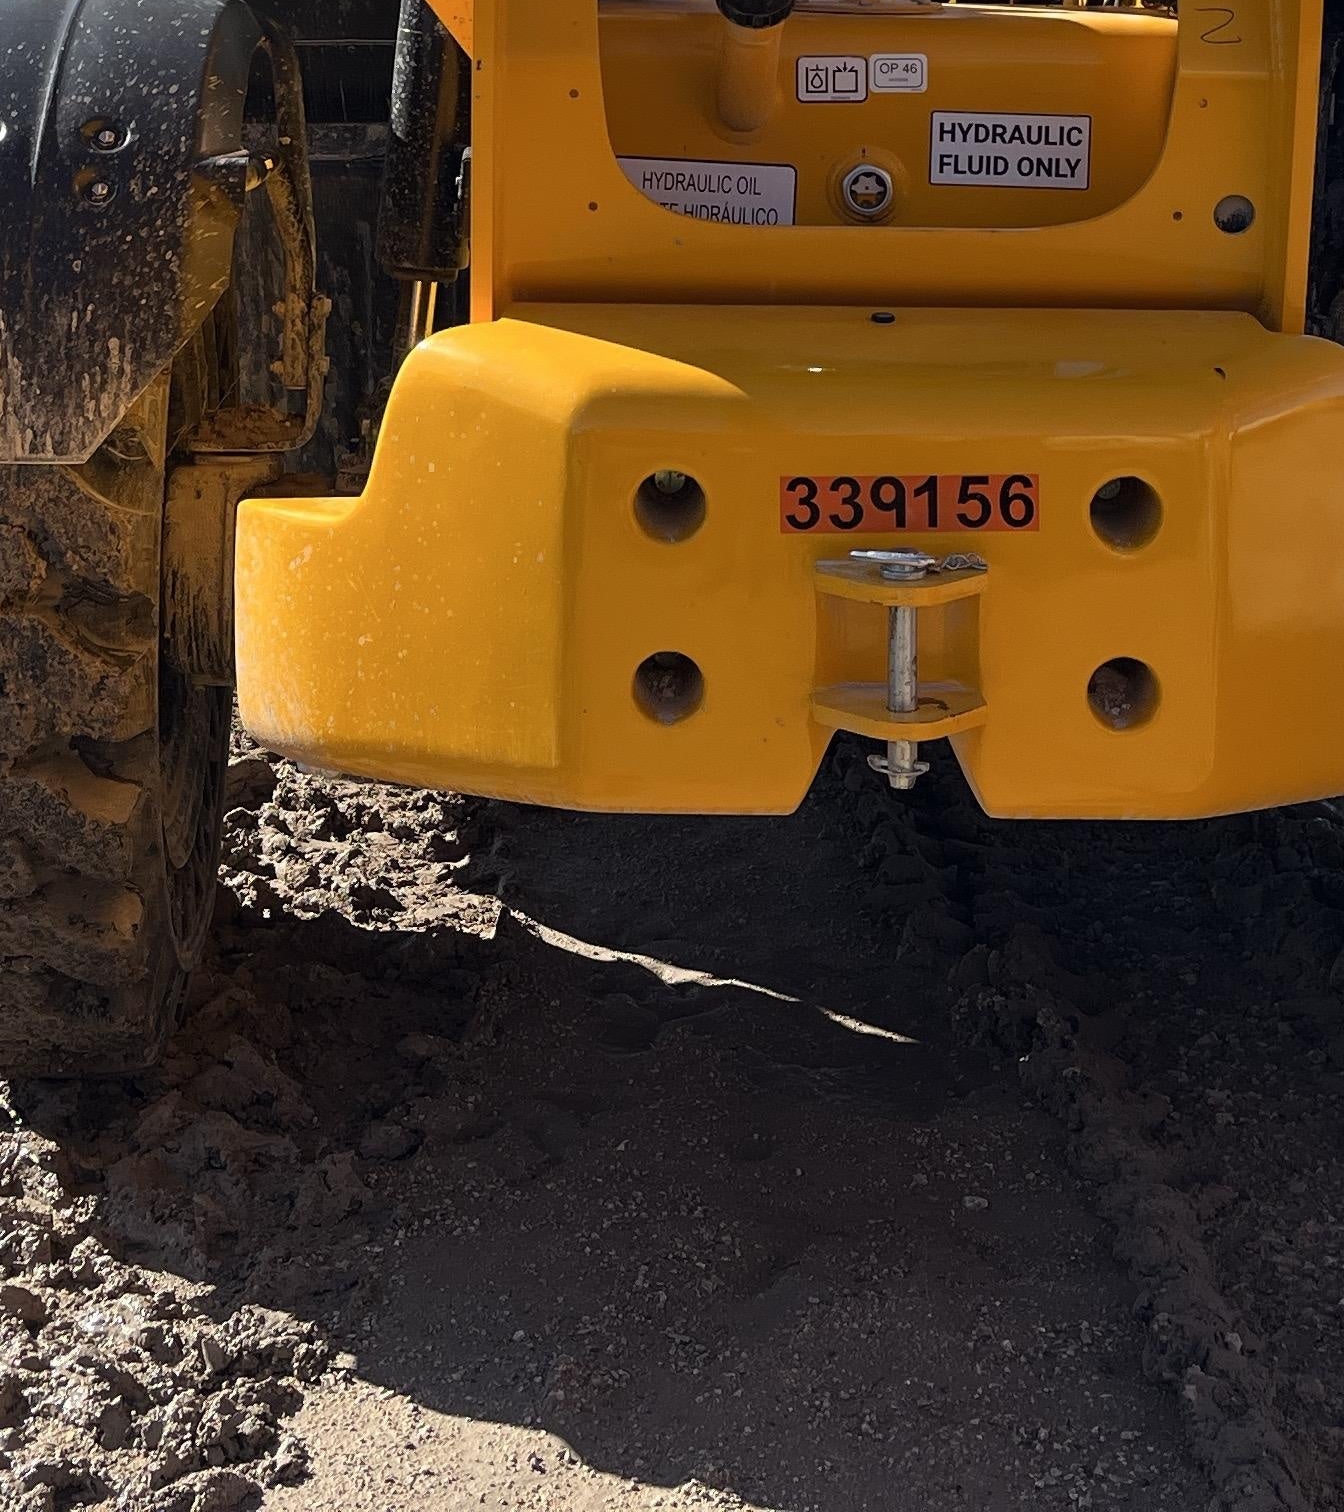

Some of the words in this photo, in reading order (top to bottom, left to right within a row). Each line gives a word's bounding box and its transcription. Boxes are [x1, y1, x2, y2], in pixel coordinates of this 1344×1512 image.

[879, 62, 899, 74] OP
[903, 62, 918, 74] 46
[938, 122, 1084, 147] HYDRAULIC
[938, 154, 1010, 176] FLUID
[1016, 157, 1082, 179] ONLY
[641, 170, 733, 195] HYDRAULIC
[736, 176, 762, 196] OIL
[784, 474, 1035, 530] 339156
